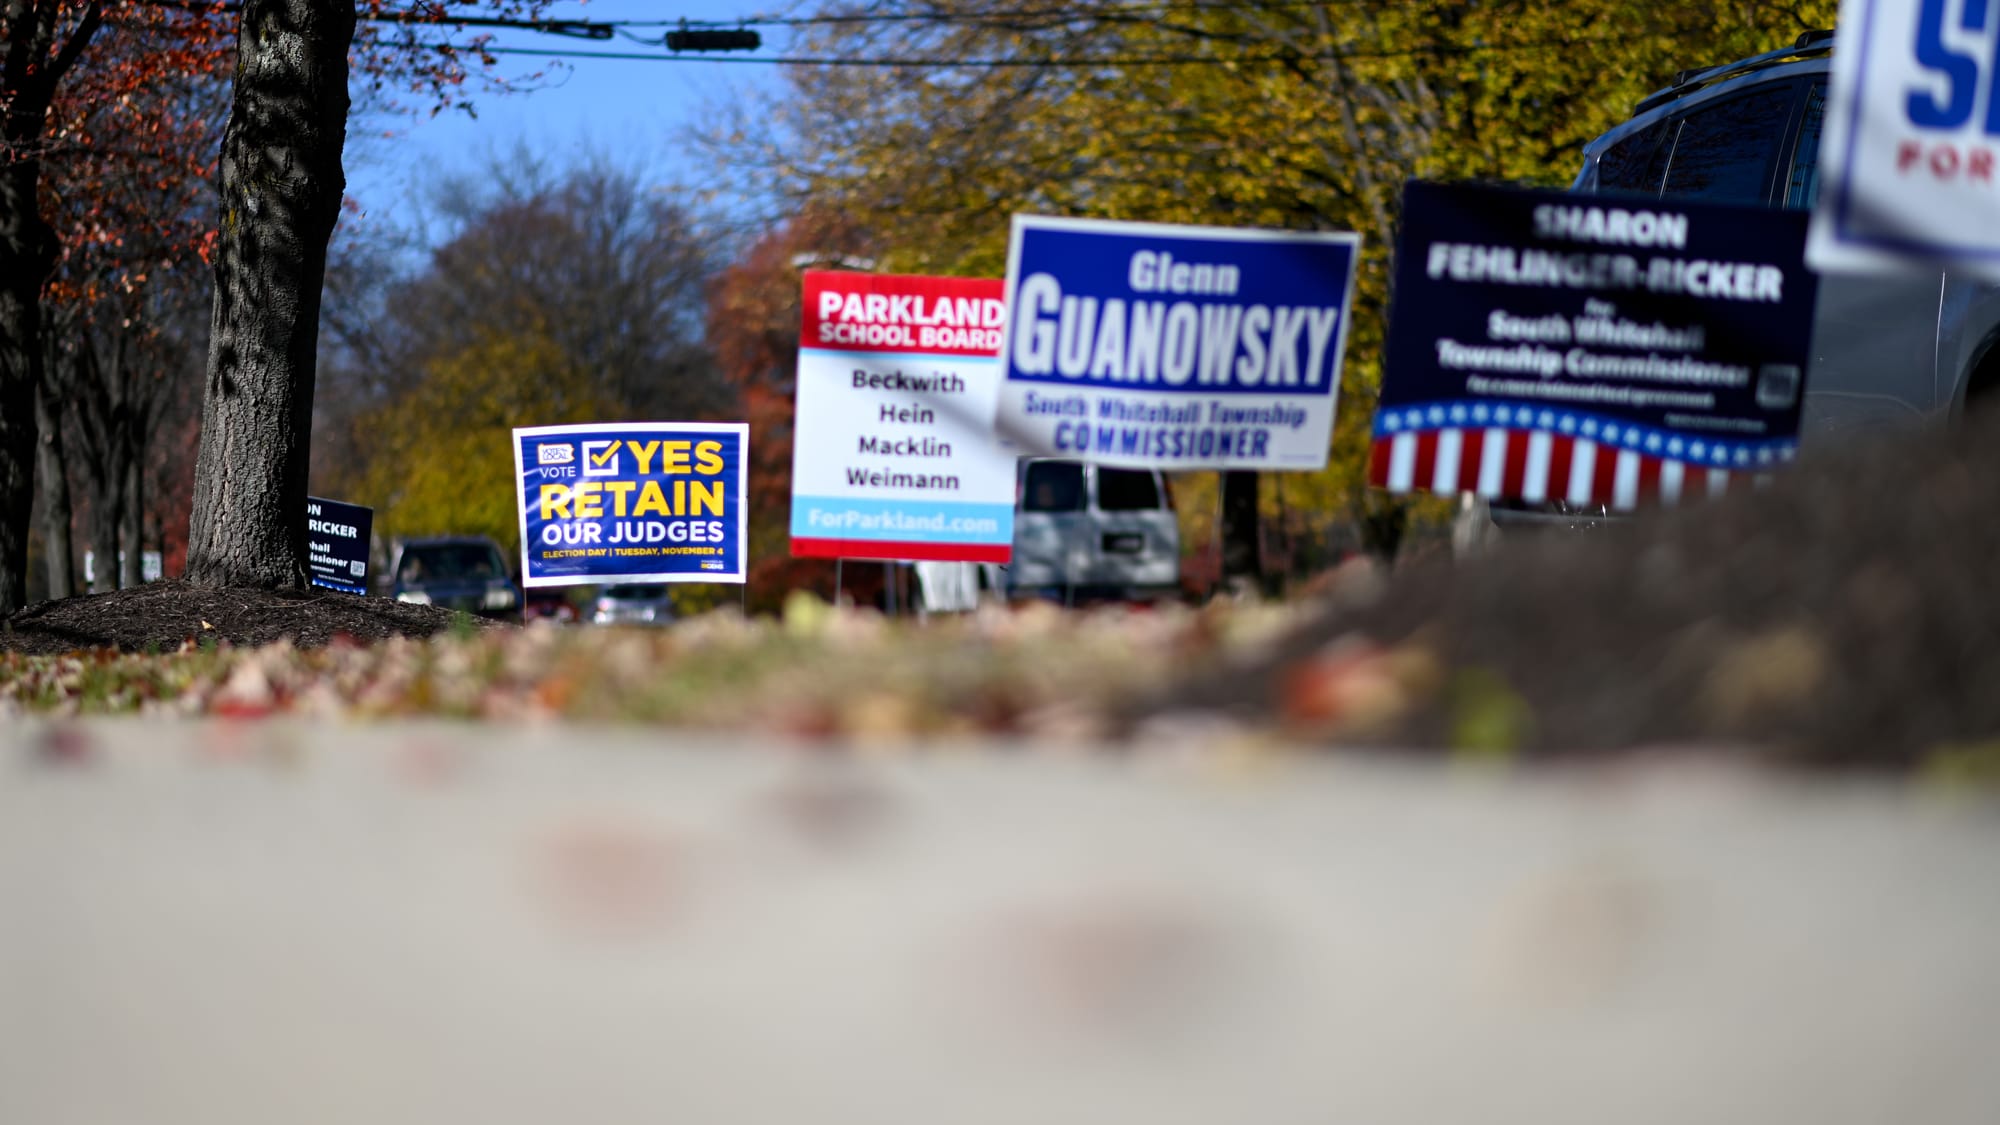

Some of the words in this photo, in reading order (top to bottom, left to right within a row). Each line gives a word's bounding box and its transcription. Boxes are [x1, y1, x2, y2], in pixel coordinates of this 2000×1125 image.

[1896, 141, 1997, 184] FOR
[1533, 205, 1688, 248] SHARON
[1129, 250, 1240, 295] Glenn
[1427, 242, 1784, 301] FEHLINGER-RICKER
[819, 291, 1006, 327] PARKLAND
[819, 322, 916, 346] SCHOOL
[919, 327, 1003, 350] BOARD
[1012, 272, 1338, 387] GUANOWSKY
[1488, 310, 1571, 342] South
[1575, 315, 1704, 350] Whitehall
[852, 369, 965, 393] Beckwith
[1436, 339, 1563, 377] Township
[1565, 349, 1750, 388] Commissioner
[879, 403, 935, 424] Hein
[1025, 391, 1087, 415] South
[1099, 397, 1200, 424] Whitehall
[1208, 402, 1308, 429] Township
[858, 436, 952, 457] Macklin
[1055, 422, 1270, 458] COMMISSIONER
[539, 466, 577, 479] VOTE
[626, 440, 724, 475] YES
[846, 468, 960, 490] Weimann
[540, 480, 725, 520] RETAIN
[542, 522, 601, 545] OUR
[608, 521, 725, 543] JUDGES
[809, 509, 997, 534] ForParkland.com
[309, 540, 331, 553] hall
[543, 548, 586, 559] ELECTION
[587, 547, 607, 557] DAY
[615, 547, 661, 557] TUESDAY,
[663, 547, 716, 556] NOVEMBER
[717, 547, 724, 556] 4
